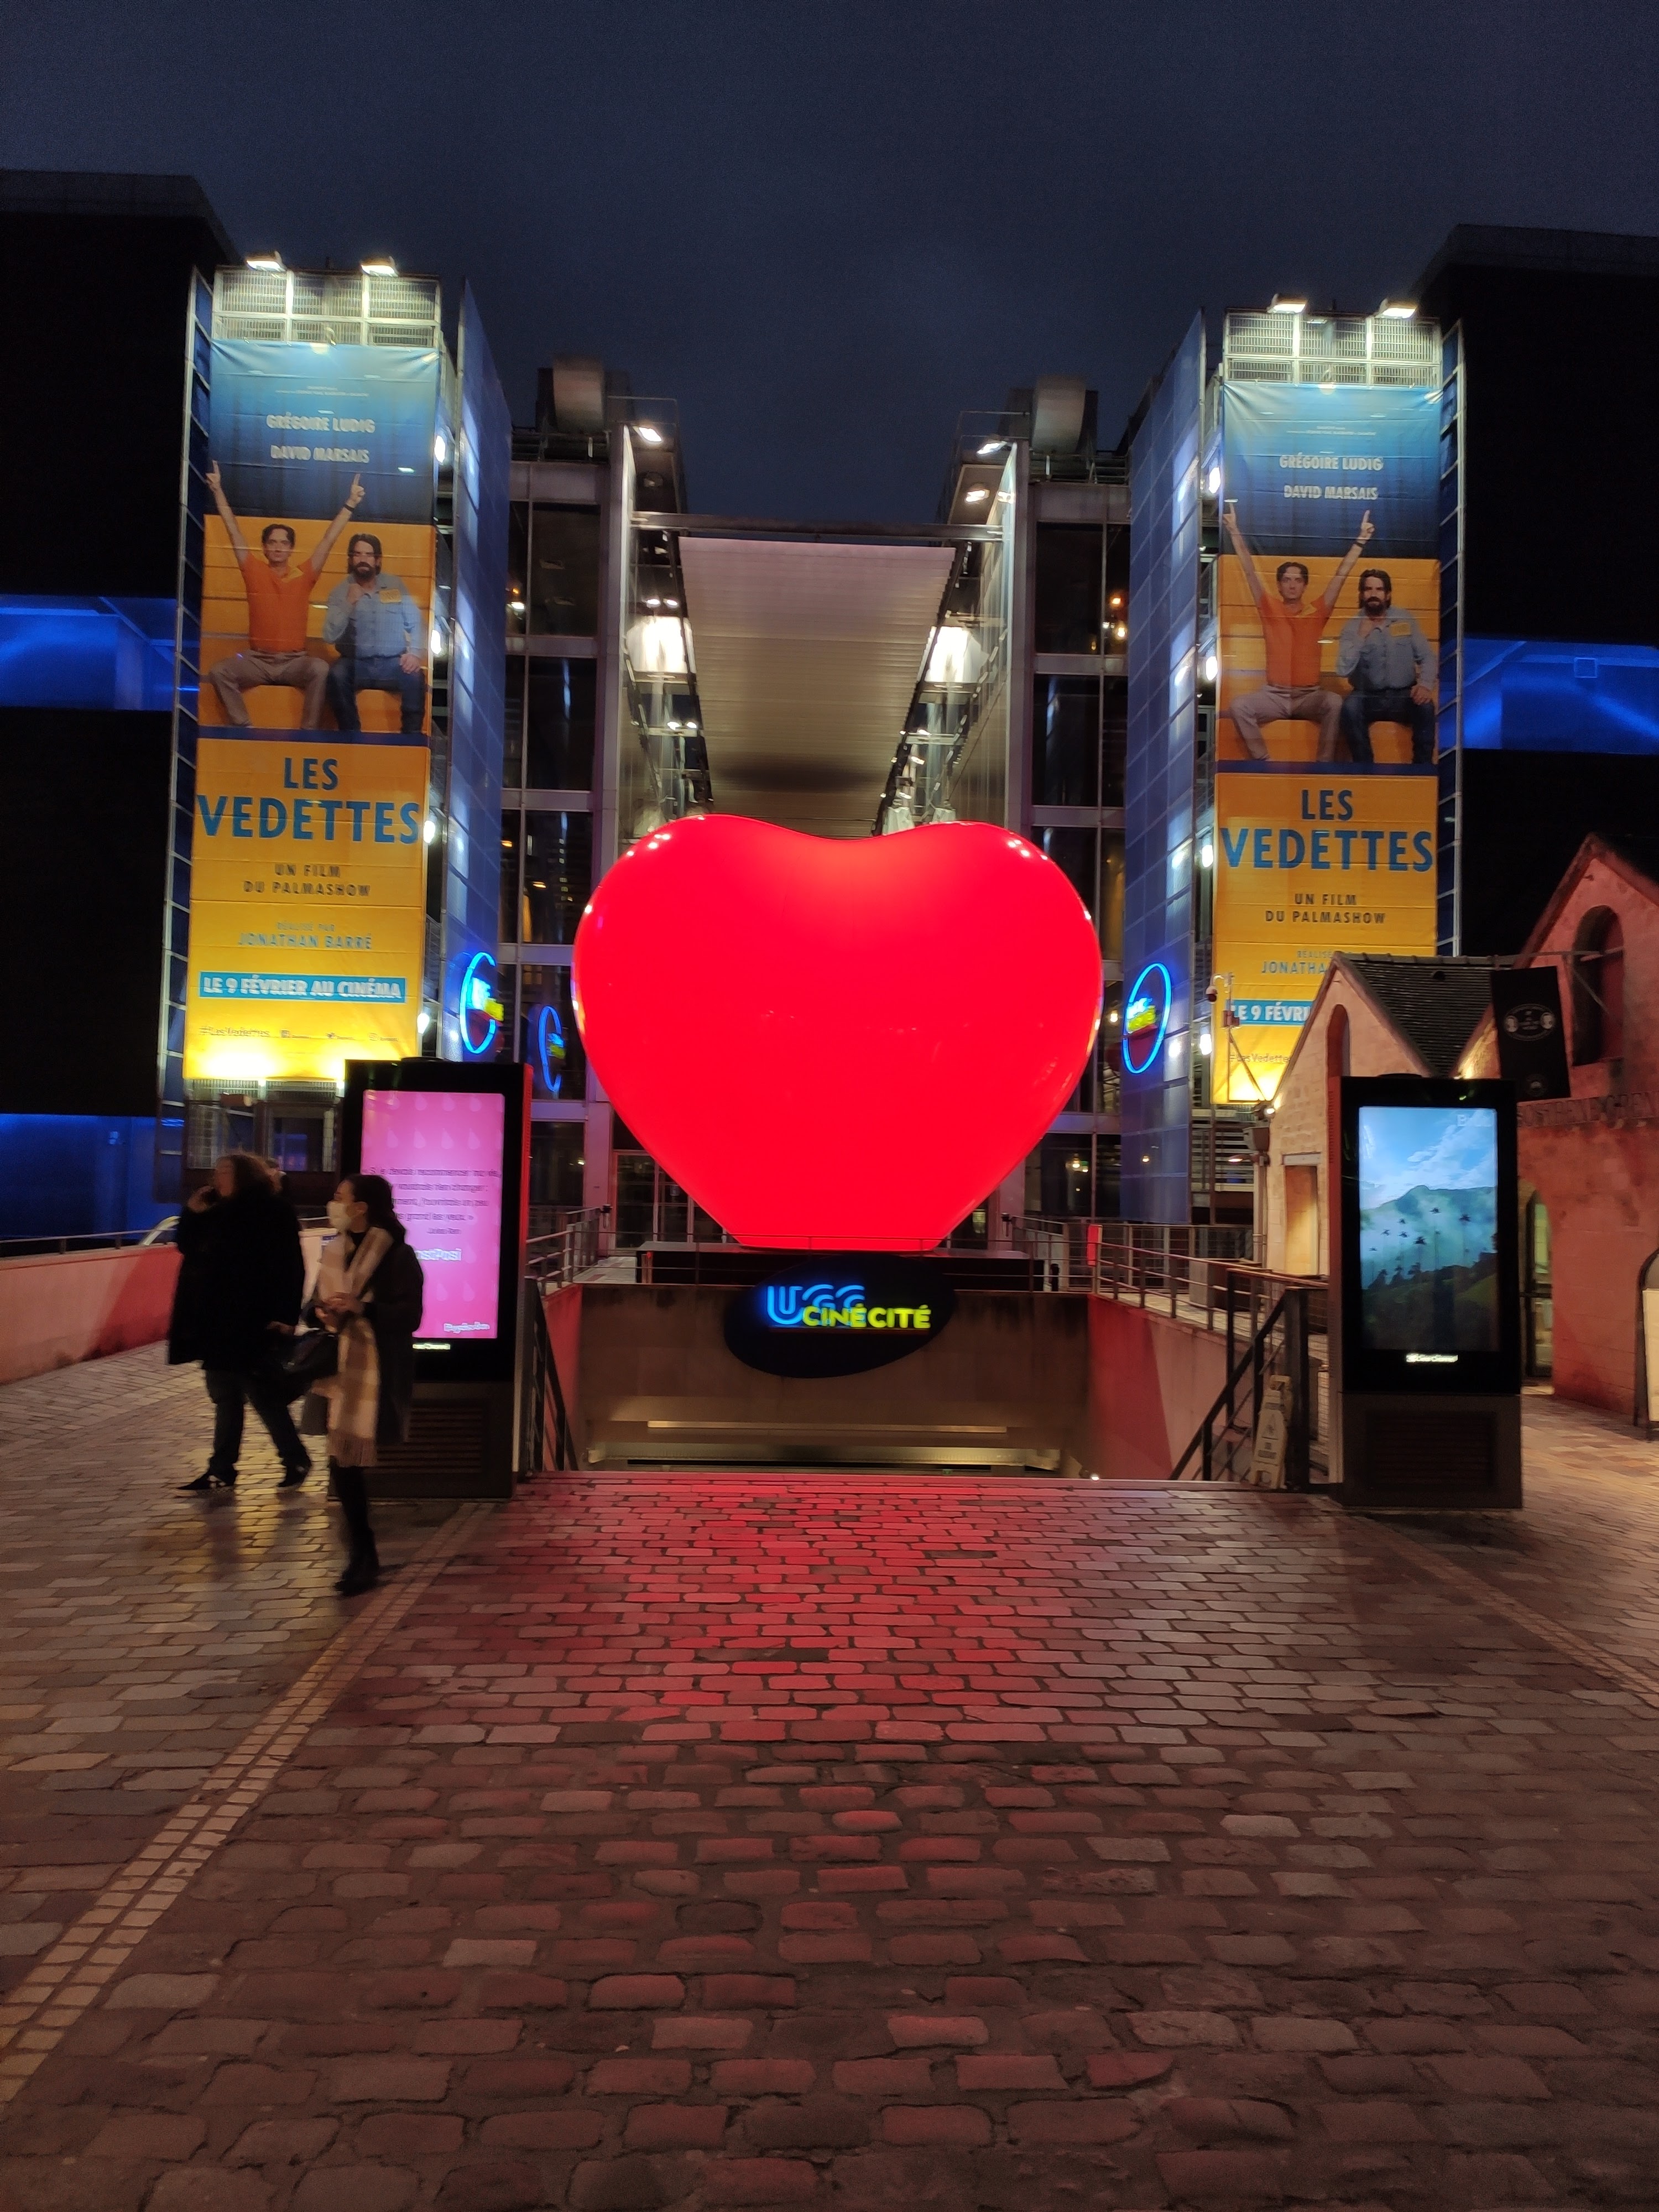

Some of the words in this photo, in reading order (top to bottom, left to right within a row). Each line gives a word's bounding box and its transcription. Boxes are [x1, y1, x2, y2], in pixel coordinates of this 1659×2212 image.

[270, 445, 311, 461] DAVID
[1279, 452, 1339, 469] GRÉGOIRE
[1342, 457, 1383, 471] LUDIG
[1284, 484, 1322, 499] DAVID
[1324, 486, 1378, 500] MARSAIS
[284, 757, 339, 790] LES
[1301, 789, 1354, 821] LES
[197, 794, 420, 844] VEDETTES
[1219, 827, 1434, 872] VEDETTES
[275, 864, 296, 877] UN
[304, 864, 341, 878] FILM
[243, 880, 265, 893] DU
[272, 881, 371, 897] PALMASHOW
[1295, 893, 1314, 905] UN
[1322, 893, 1357, 906] FILM
[1265, 910, 1285, 922] DU
[1292, 910, 1386, 924] PALMASHOW
[1261, 961, 1327, 974] JONATHA
[204, 977, 223, 994] LE
[225, 977, 238, 994] 9
[240, 974, 308, 996] FÉVRIER
[310, 980, 335, 997] AU
[337, 978, 402, 999] CINÉMA
[1251, 1005, 1261, 1020] 9
[1265, 1001, 1311, 1021] FÉVRI
